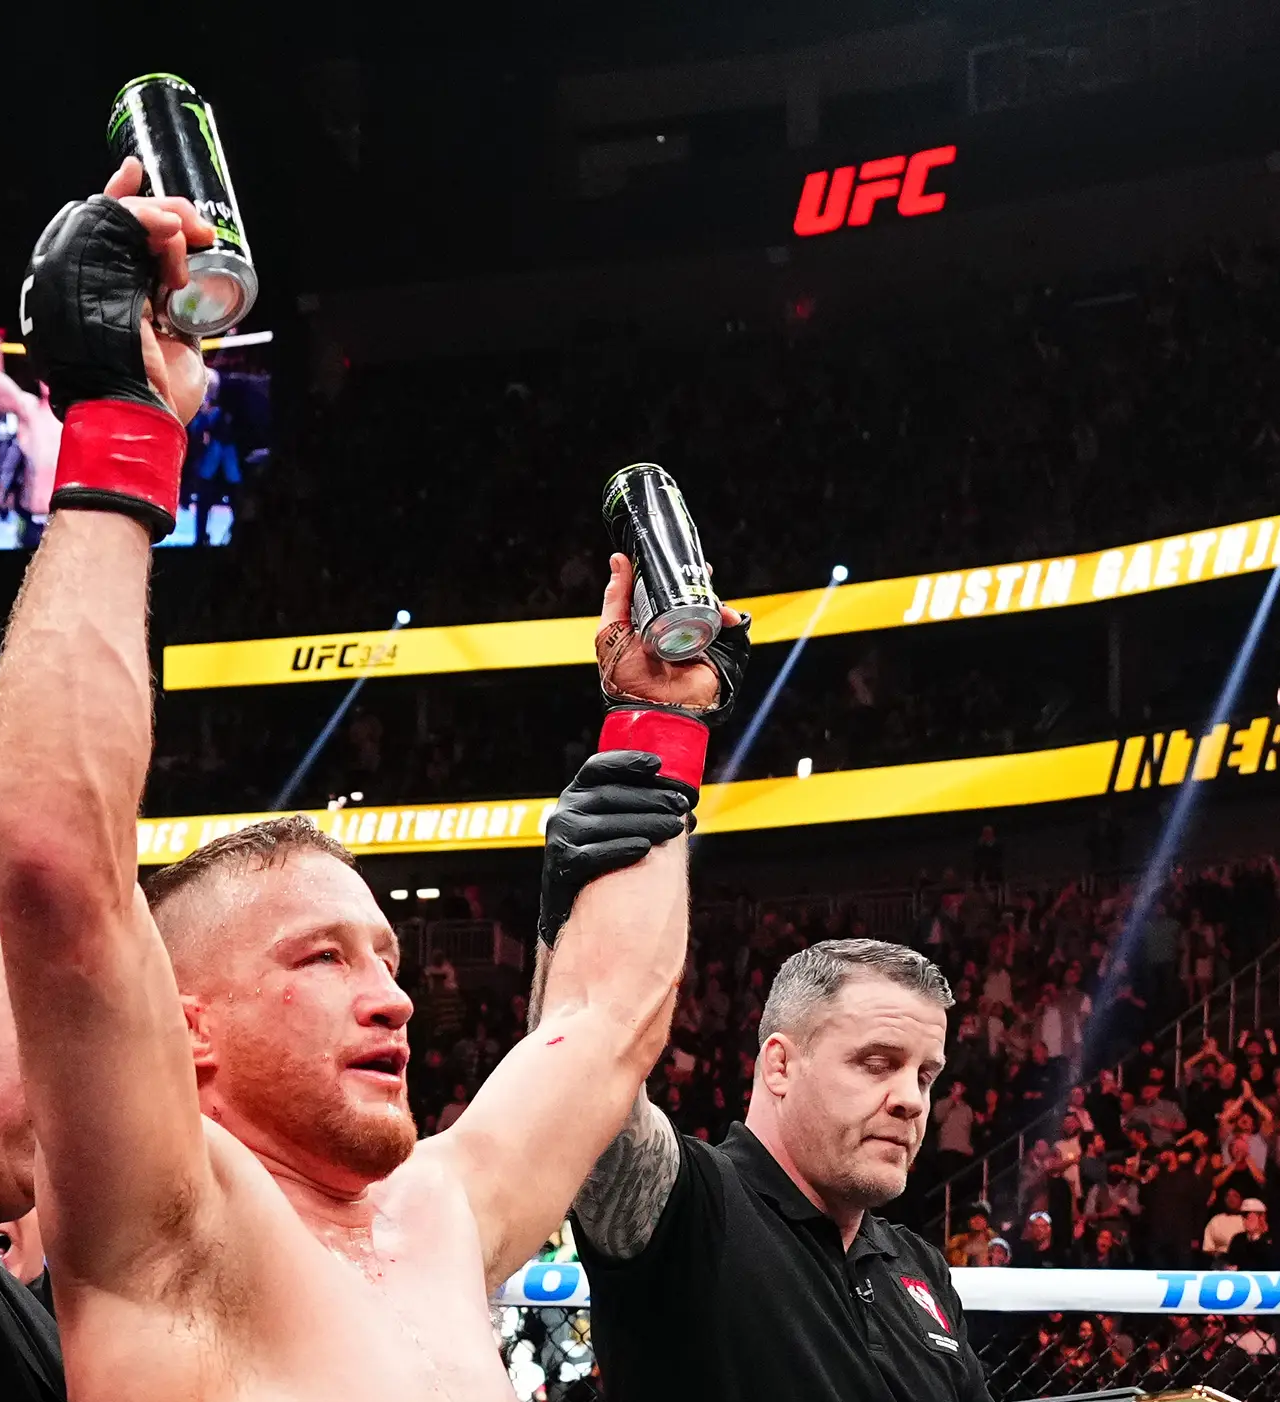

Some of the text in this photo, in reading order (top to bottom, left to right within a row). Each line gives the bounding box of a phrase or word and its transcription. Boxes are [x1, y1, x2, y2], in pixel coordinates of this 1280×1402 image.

[792, 145, 957, 237] UFC
[903, 560, 1078, 623] JUSTIN
[290, 642, 360, 672] UFC
